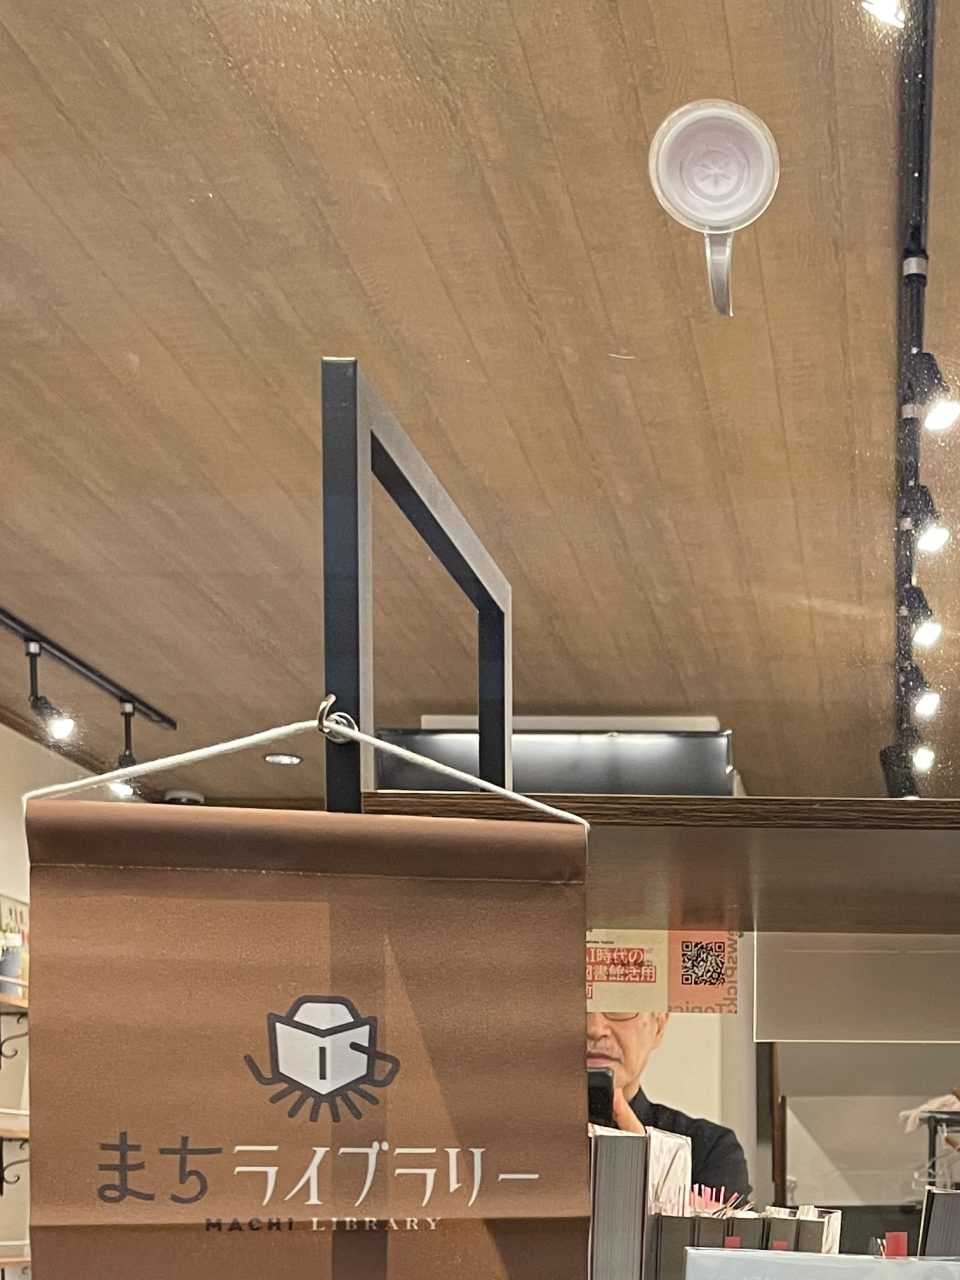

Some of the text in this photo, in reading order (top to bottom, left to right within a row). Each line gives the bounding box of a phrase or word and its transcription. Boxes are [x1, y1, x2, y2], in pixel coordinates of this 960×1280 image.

[586, 948, 644, 964] I時代の
[96, 1129, 540, 1208] まちライブラリー
[205, 1216, 444, 1232] MACHI LIBRARY
